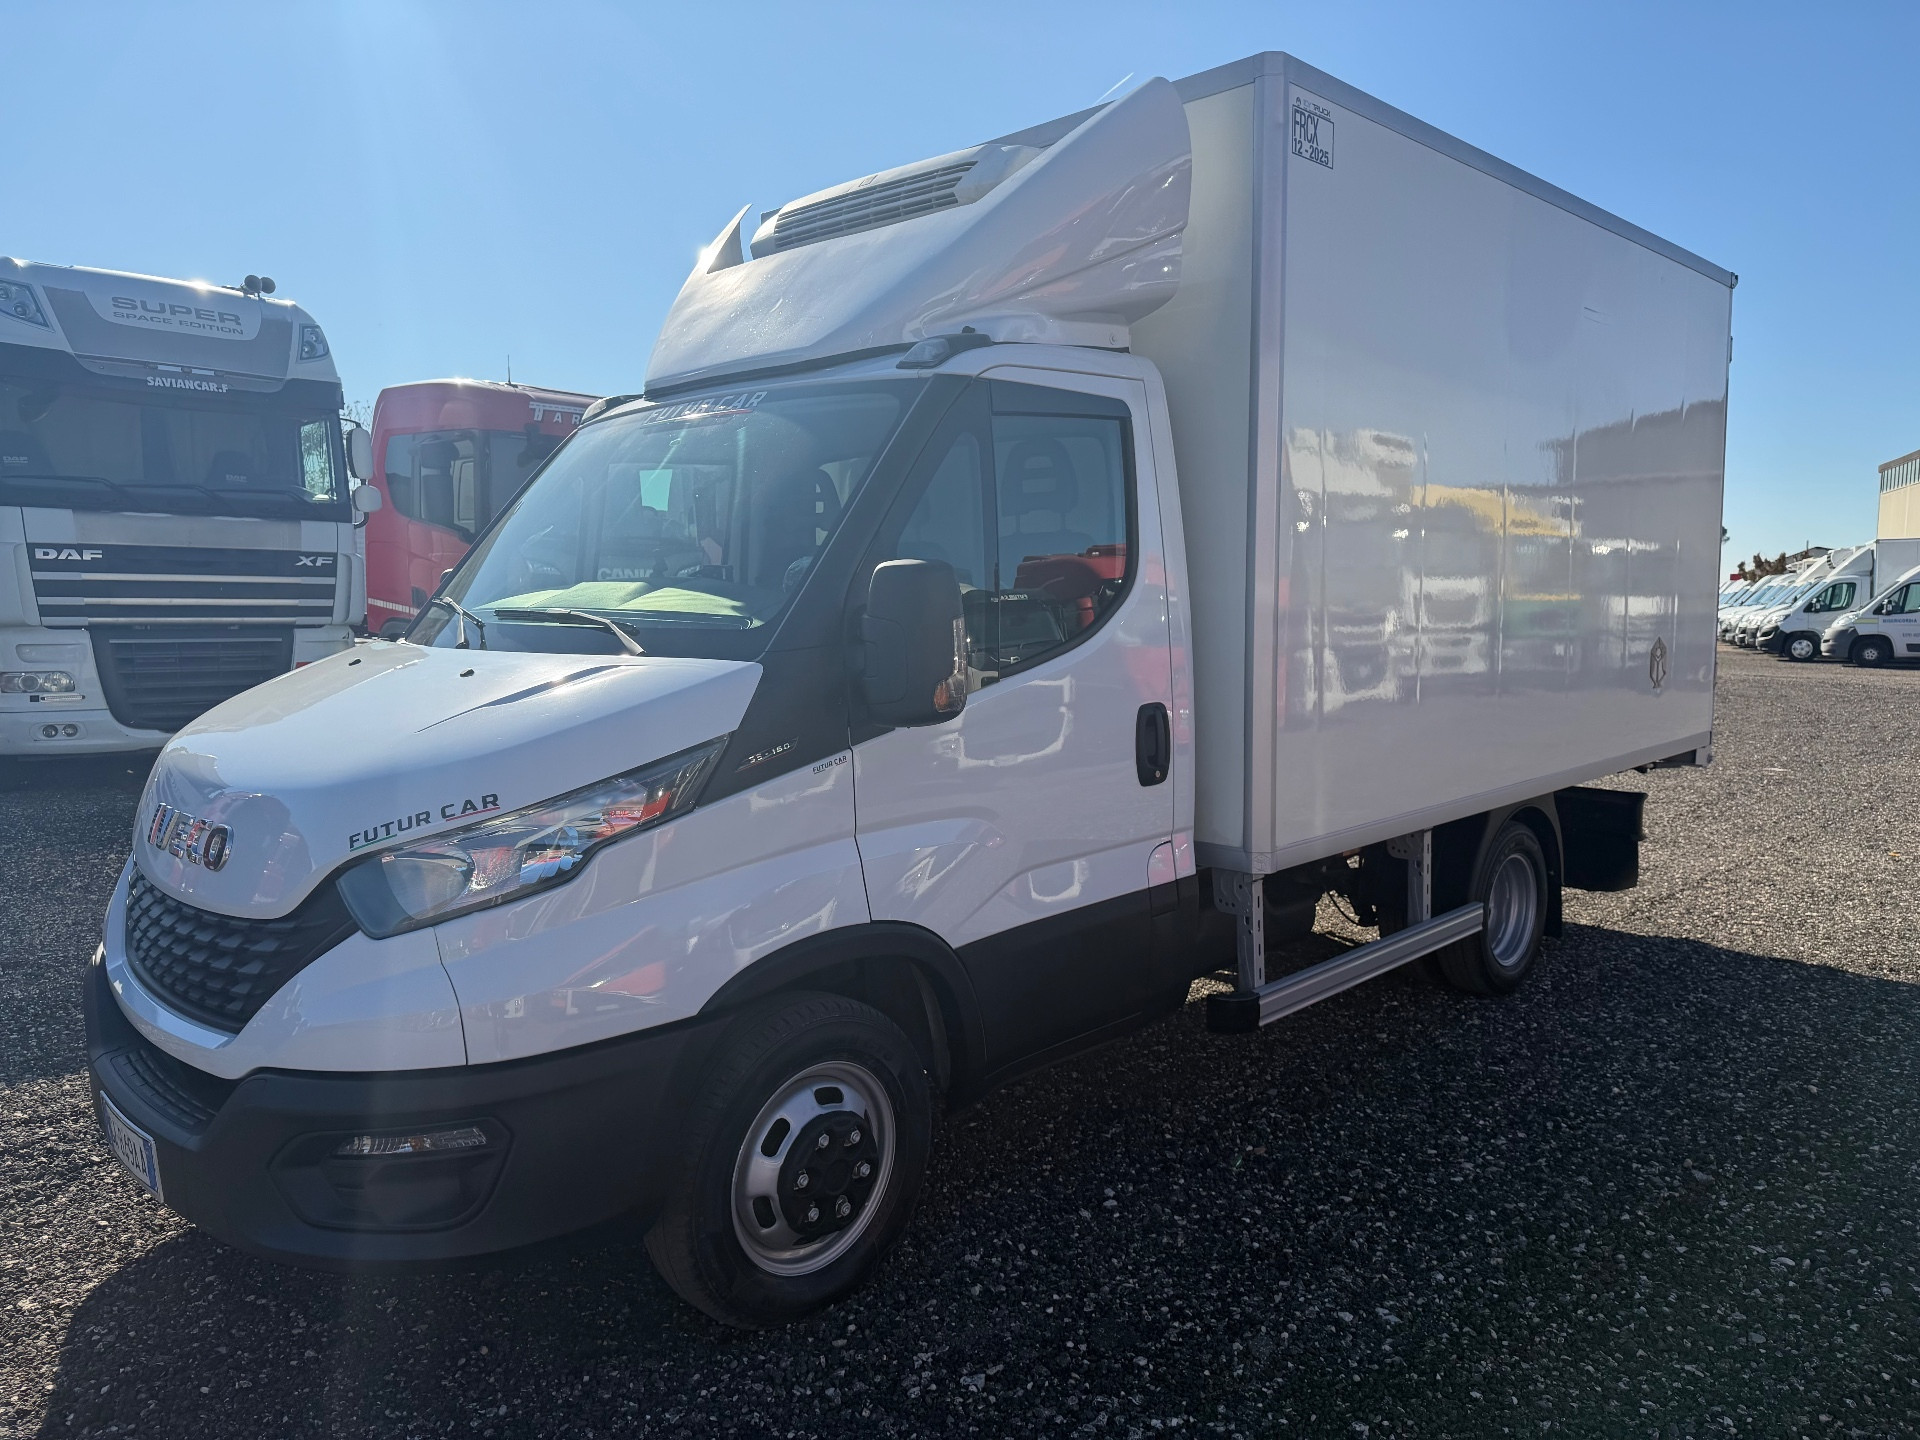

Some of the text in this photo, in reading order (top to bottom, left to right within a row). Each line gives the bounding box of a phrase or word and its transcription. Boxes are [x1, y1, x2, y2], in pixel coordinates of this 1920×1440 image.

[1294, 108, 1319, 147] FRCX
[112, 296, 242, 326] SUPER
[113, 312, 244, 335] SPACE EDITION
[713, 391, 768, 412] CAR
[34, 548, 103, 561] DAF
[295, 555, 334, 567] XF
[812, 755, 847, 772] FUTUR CAR
[349, 794, 499, 848] FUTUR CAR
[147, 802, 235, 873] IVECO
